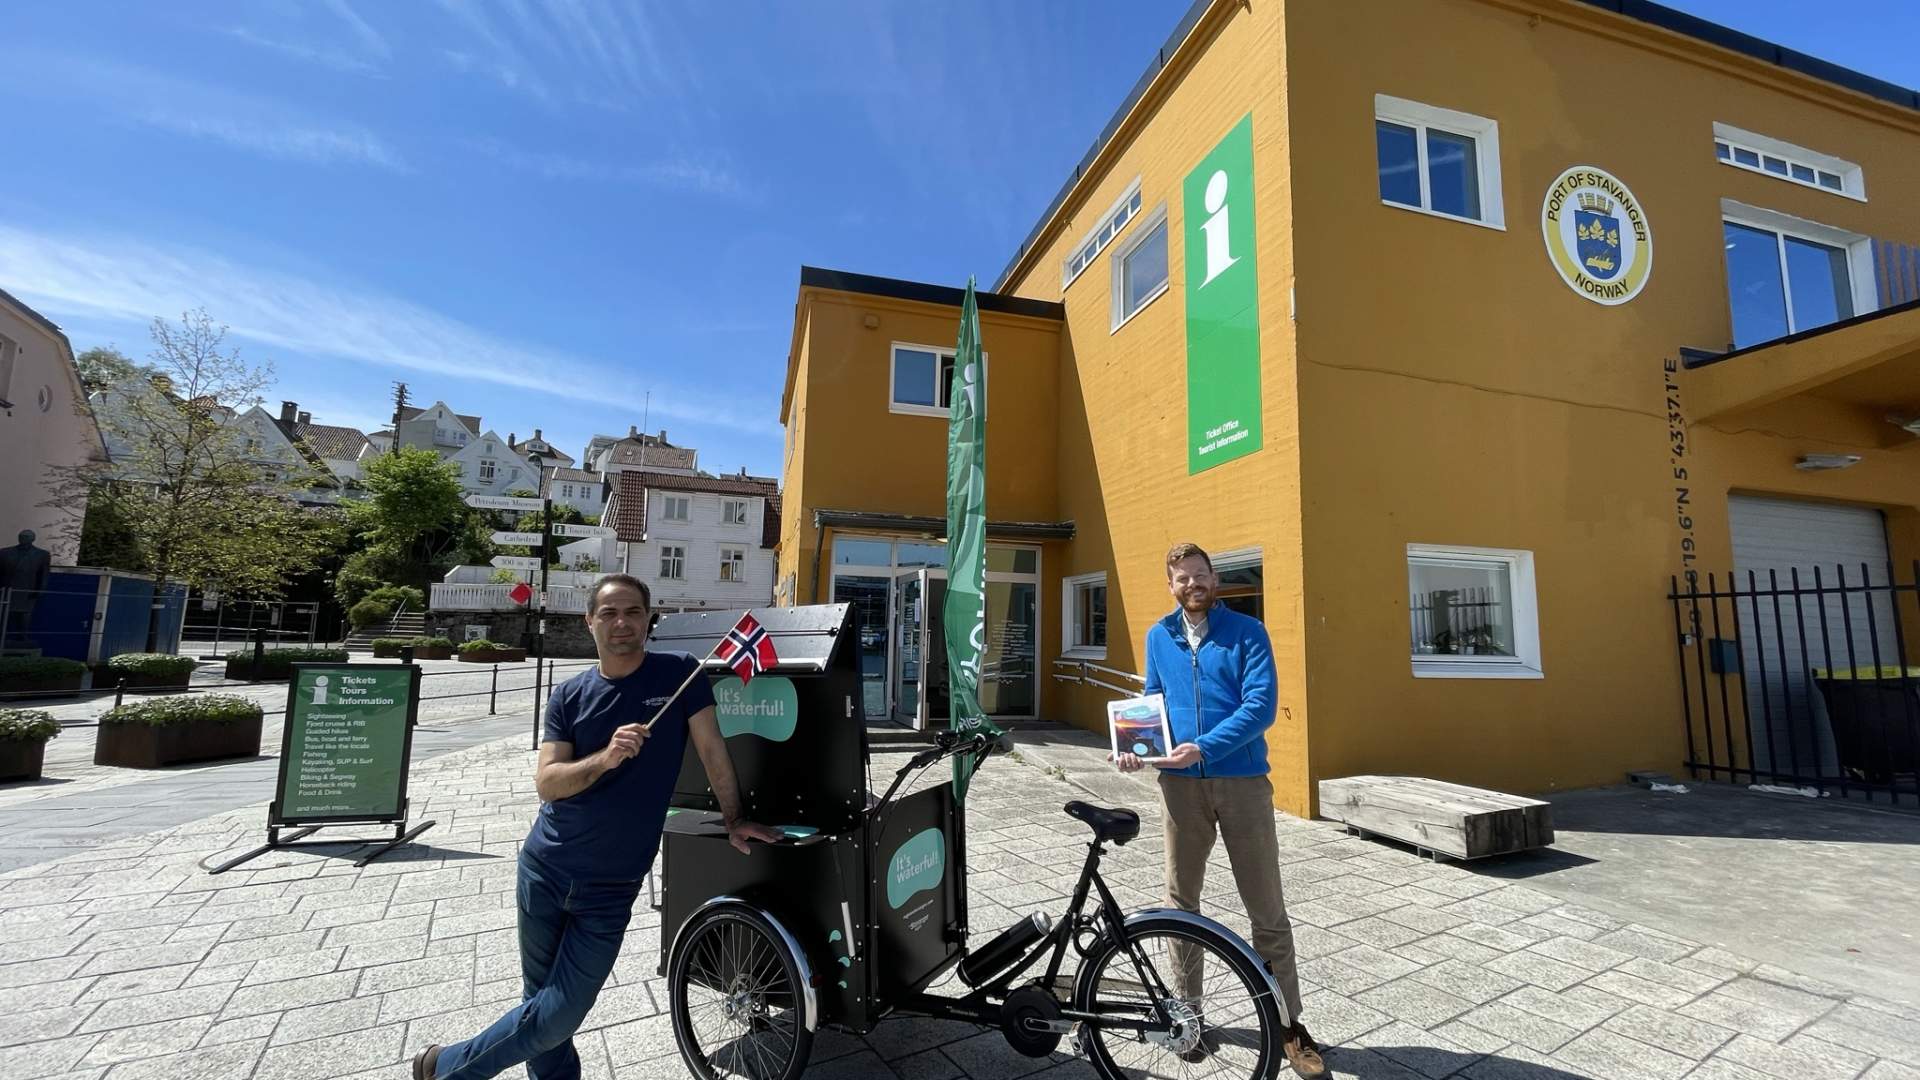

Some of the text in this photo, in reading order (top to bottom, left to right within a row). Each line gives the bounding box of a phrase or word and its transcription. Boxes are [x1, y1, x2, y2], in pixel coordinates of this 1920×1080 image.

[1548, 173, 1646, 242] PORT OF STAVANGER
[1575, 273, 1630, 298] NORWAY
[1206, 420, 1239, 440] Ticket Office
[1198, 429, 1249, 456] Tourist Information
[474, 497, 541, 508] Petroleum Museum
[504, 535, 538, 543] Cathedral
[568, 527, 607, 535] Tourist Info
[341, 676, 377, 684] Tickets
[340, 687, 367, 695] Tours
[719, 687, 740, 703] It's
[338, 697, 394, 705] Information
[719, 700, 784, 716] waterful!
[306, 713, 347, 721] Sightseeing
[896, 854, 912, 871] It's
[896, 850, 939, 884] waterful!
